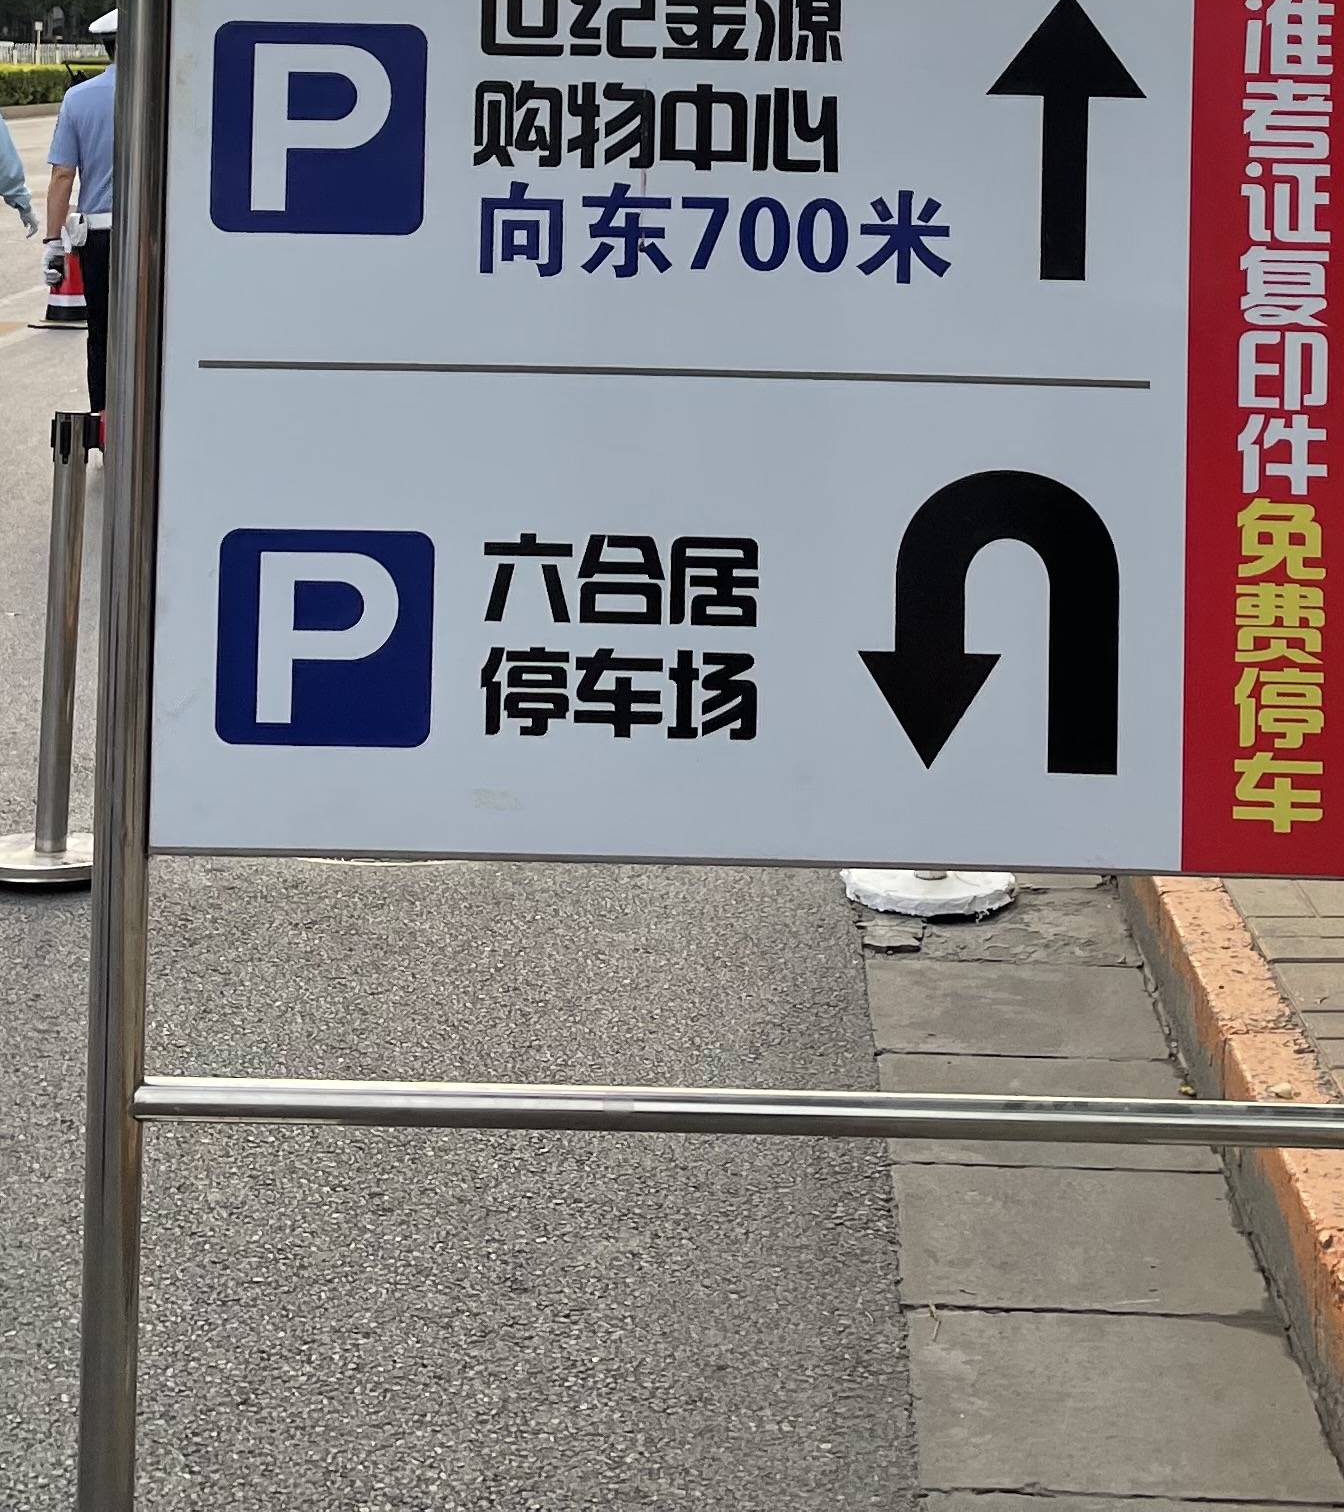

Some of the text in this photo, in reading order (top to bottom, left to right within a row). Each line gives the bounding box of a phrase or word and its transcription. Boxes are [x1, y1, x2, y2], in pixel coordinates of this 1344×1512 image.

[251, 43, 392, 212] P
[473, 80, 839, 173] 购物中心
[478, 181, 952, 285] 向东700米
[483, 532, 760, 628] 六合居
[256, 551, 399, 724] P
[480, 646, 758, 741] 停车场
